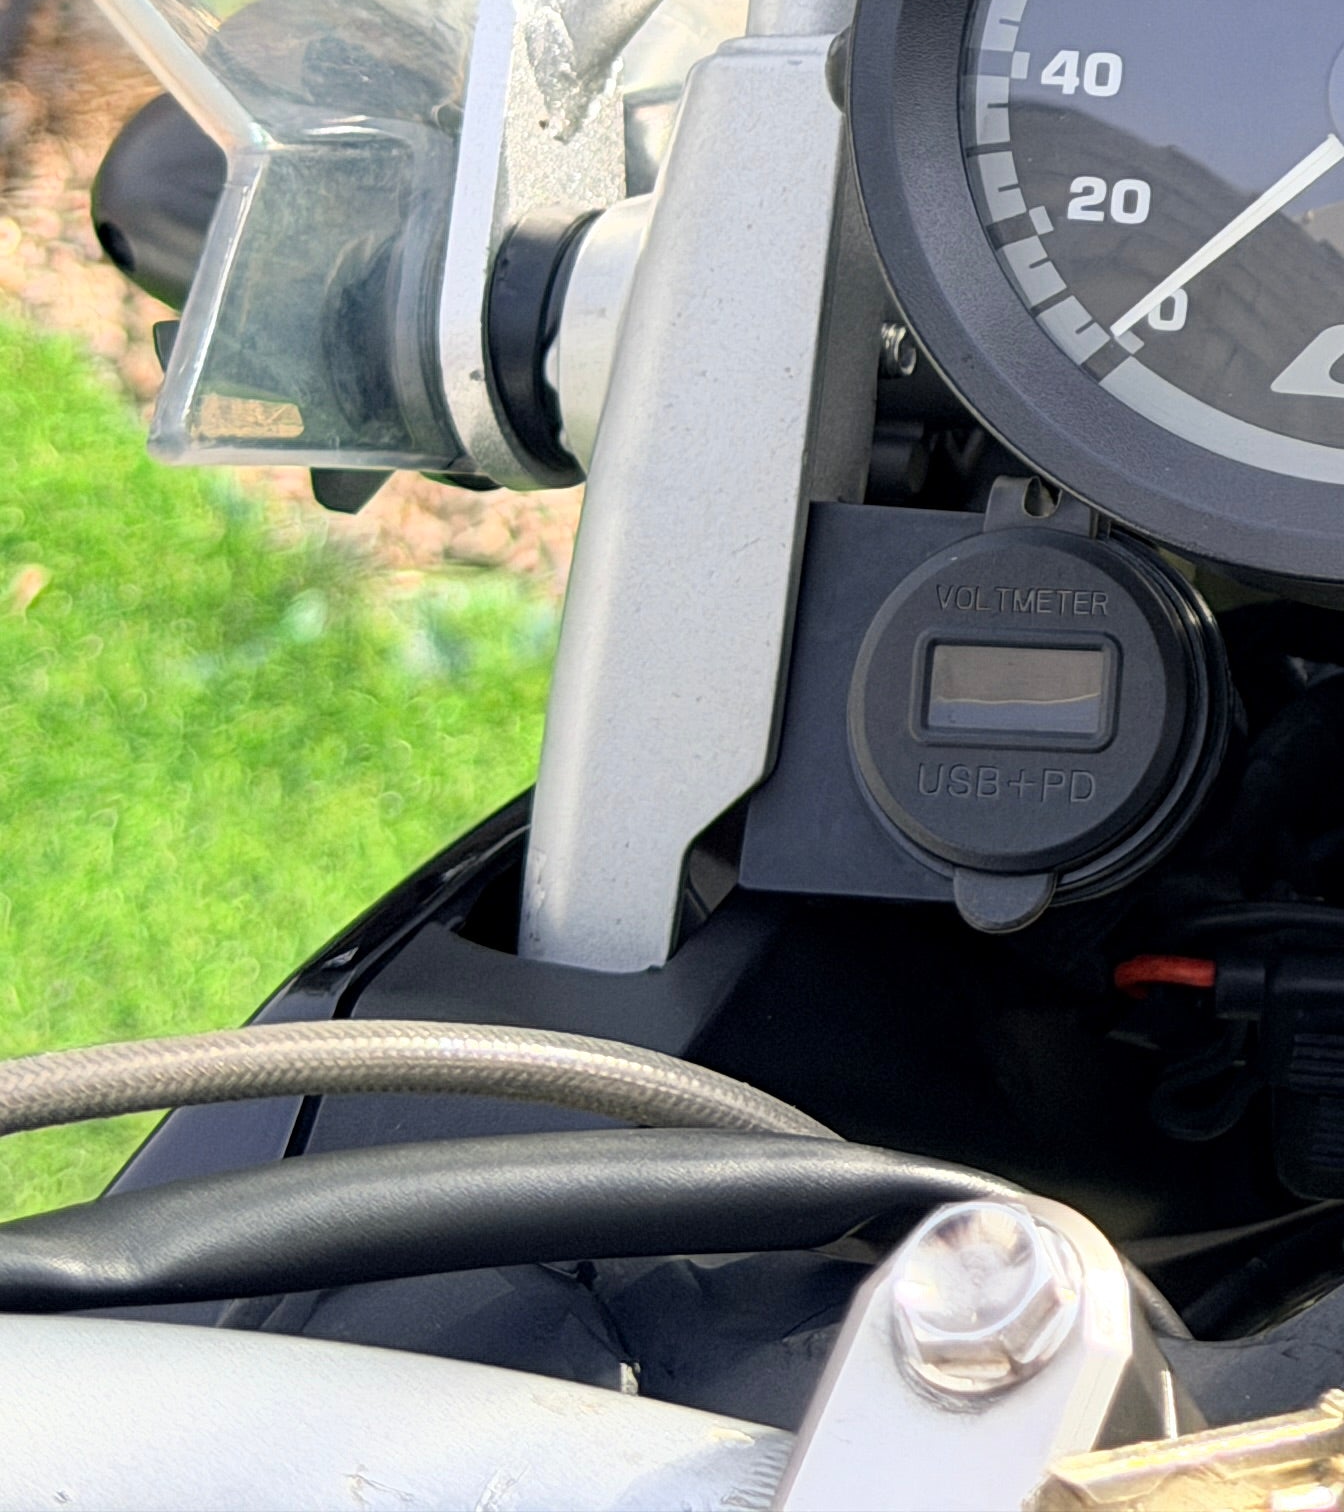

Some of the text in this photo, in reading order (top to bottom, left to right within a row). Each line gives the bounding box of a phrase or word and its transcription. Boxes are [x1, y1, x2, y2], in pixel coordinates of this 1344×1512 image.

[1040, 49, 1123, 97] 40
[1066, 176, 1151, 225] 20
[1147, 287, 1188, 331] 0
[936, 584, 1110, 616] VOLTMETER
[917, 762, 1097, 805] USB+PD
